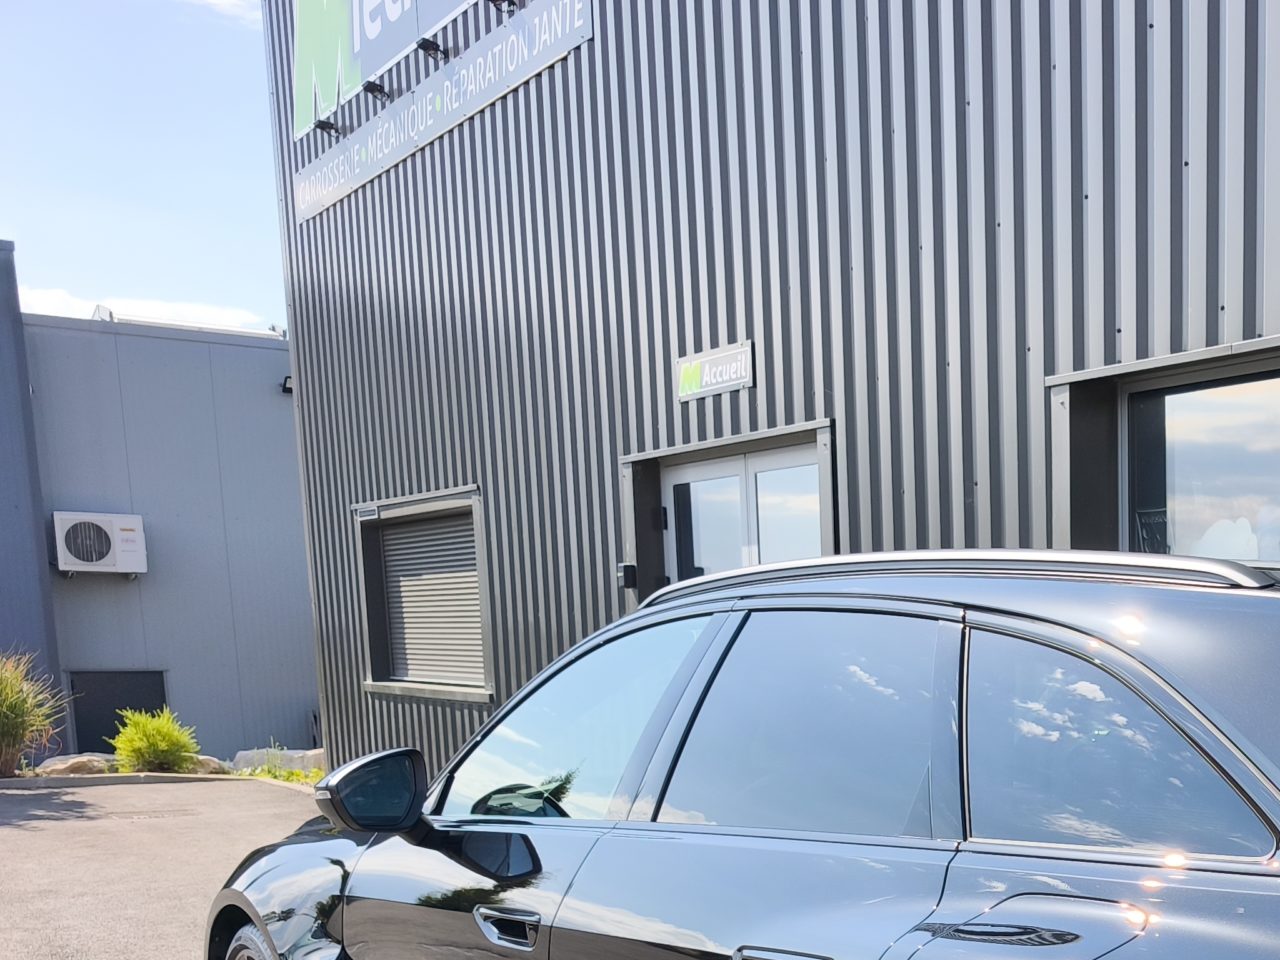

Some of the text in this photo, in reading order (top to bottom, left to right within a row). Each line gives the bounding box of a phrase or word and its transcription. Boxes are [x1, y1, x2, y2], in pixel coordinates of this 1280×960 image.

[299, 143, 360, 210] CARROSSERIE
[367, 92, 434, 165] MÉCANIQUE
[444, 25, 528, 116] RÉPARATION
[533, 0, 583, 56] JANTE
[703, 352, 746, 386] Accueil
